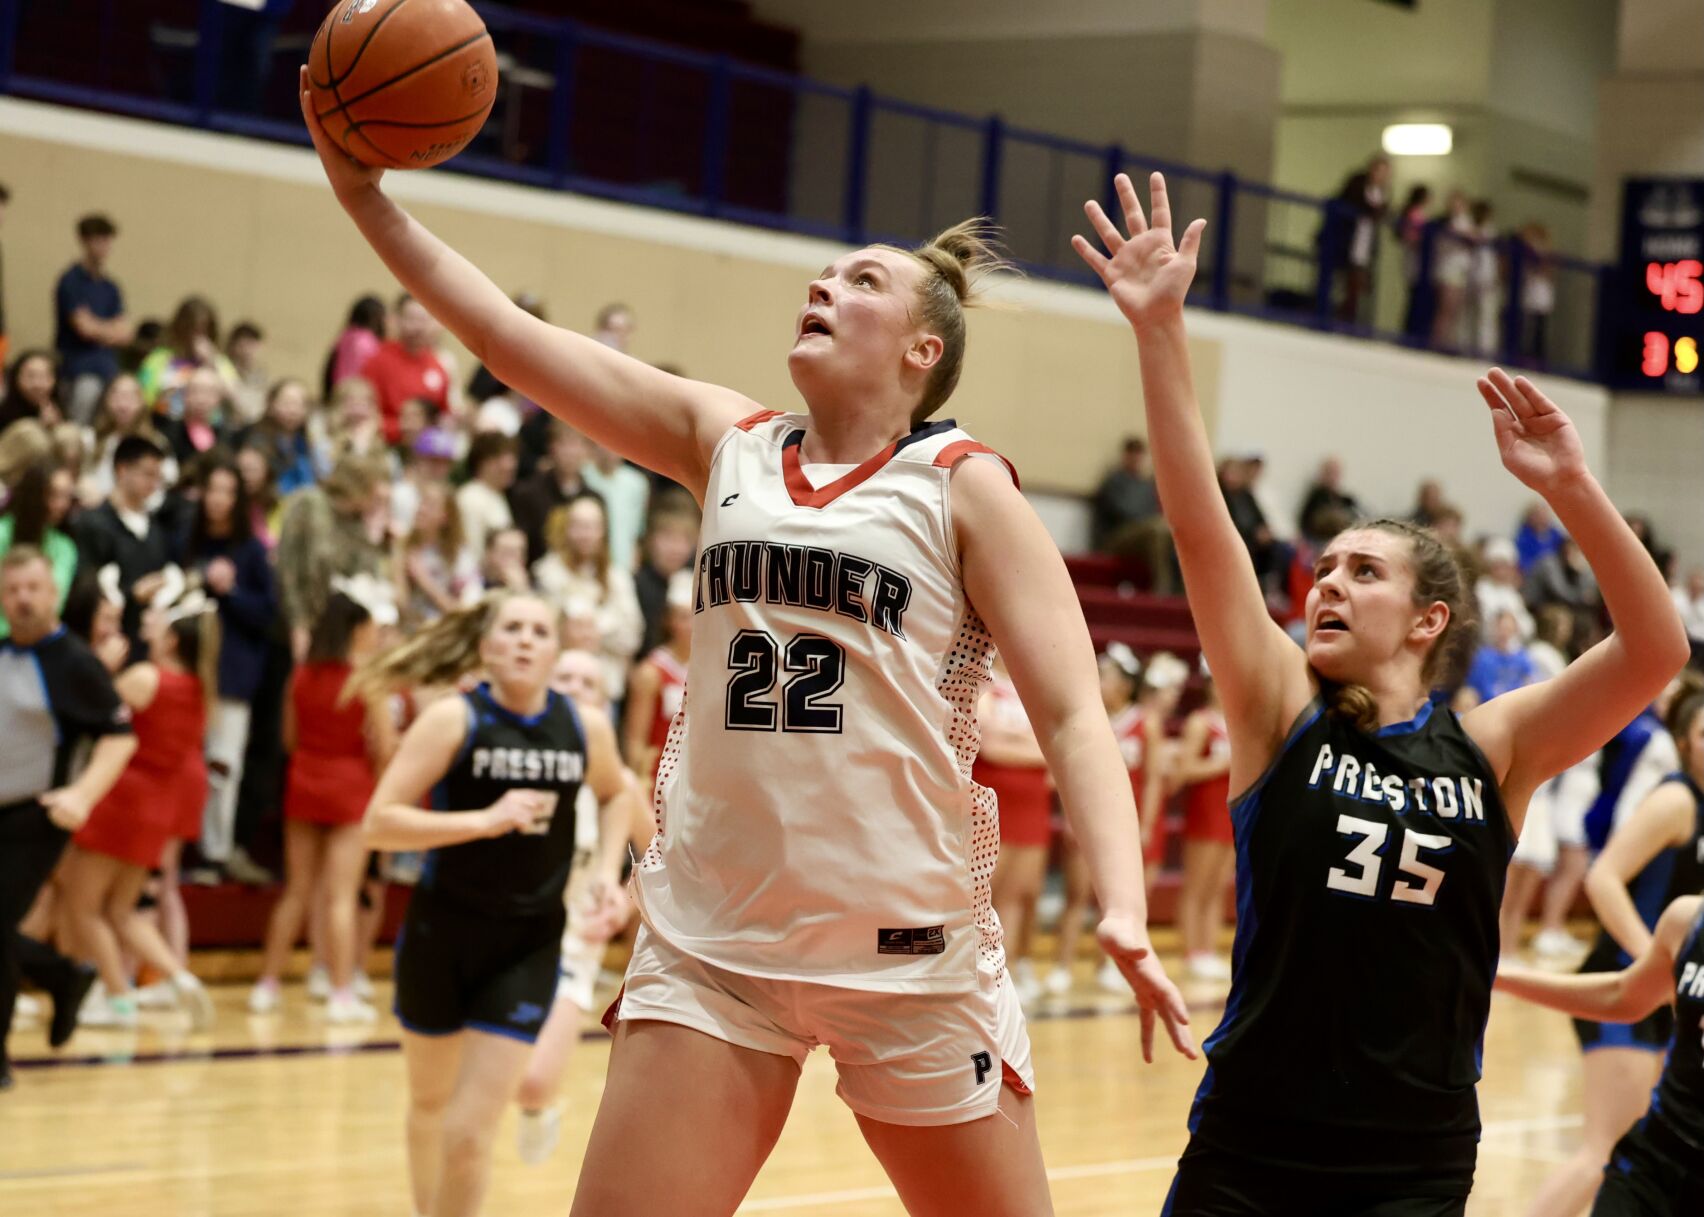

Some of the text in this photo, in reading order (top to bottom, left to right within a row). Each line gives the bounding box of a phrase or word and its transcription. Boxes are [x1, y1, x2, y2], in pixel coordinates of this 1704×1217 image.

[1646, 259, 1704, 314] 45
[694, 540, 912, 642] THUNDER
[725, 628, 846, 734] 22
[472, 746, 583, 782] PRESTON
[1308, 743, 1484, 820] PRESTON
[1326, 814, 1452, 906] 35
[970, 1050, 992, 1086] P
